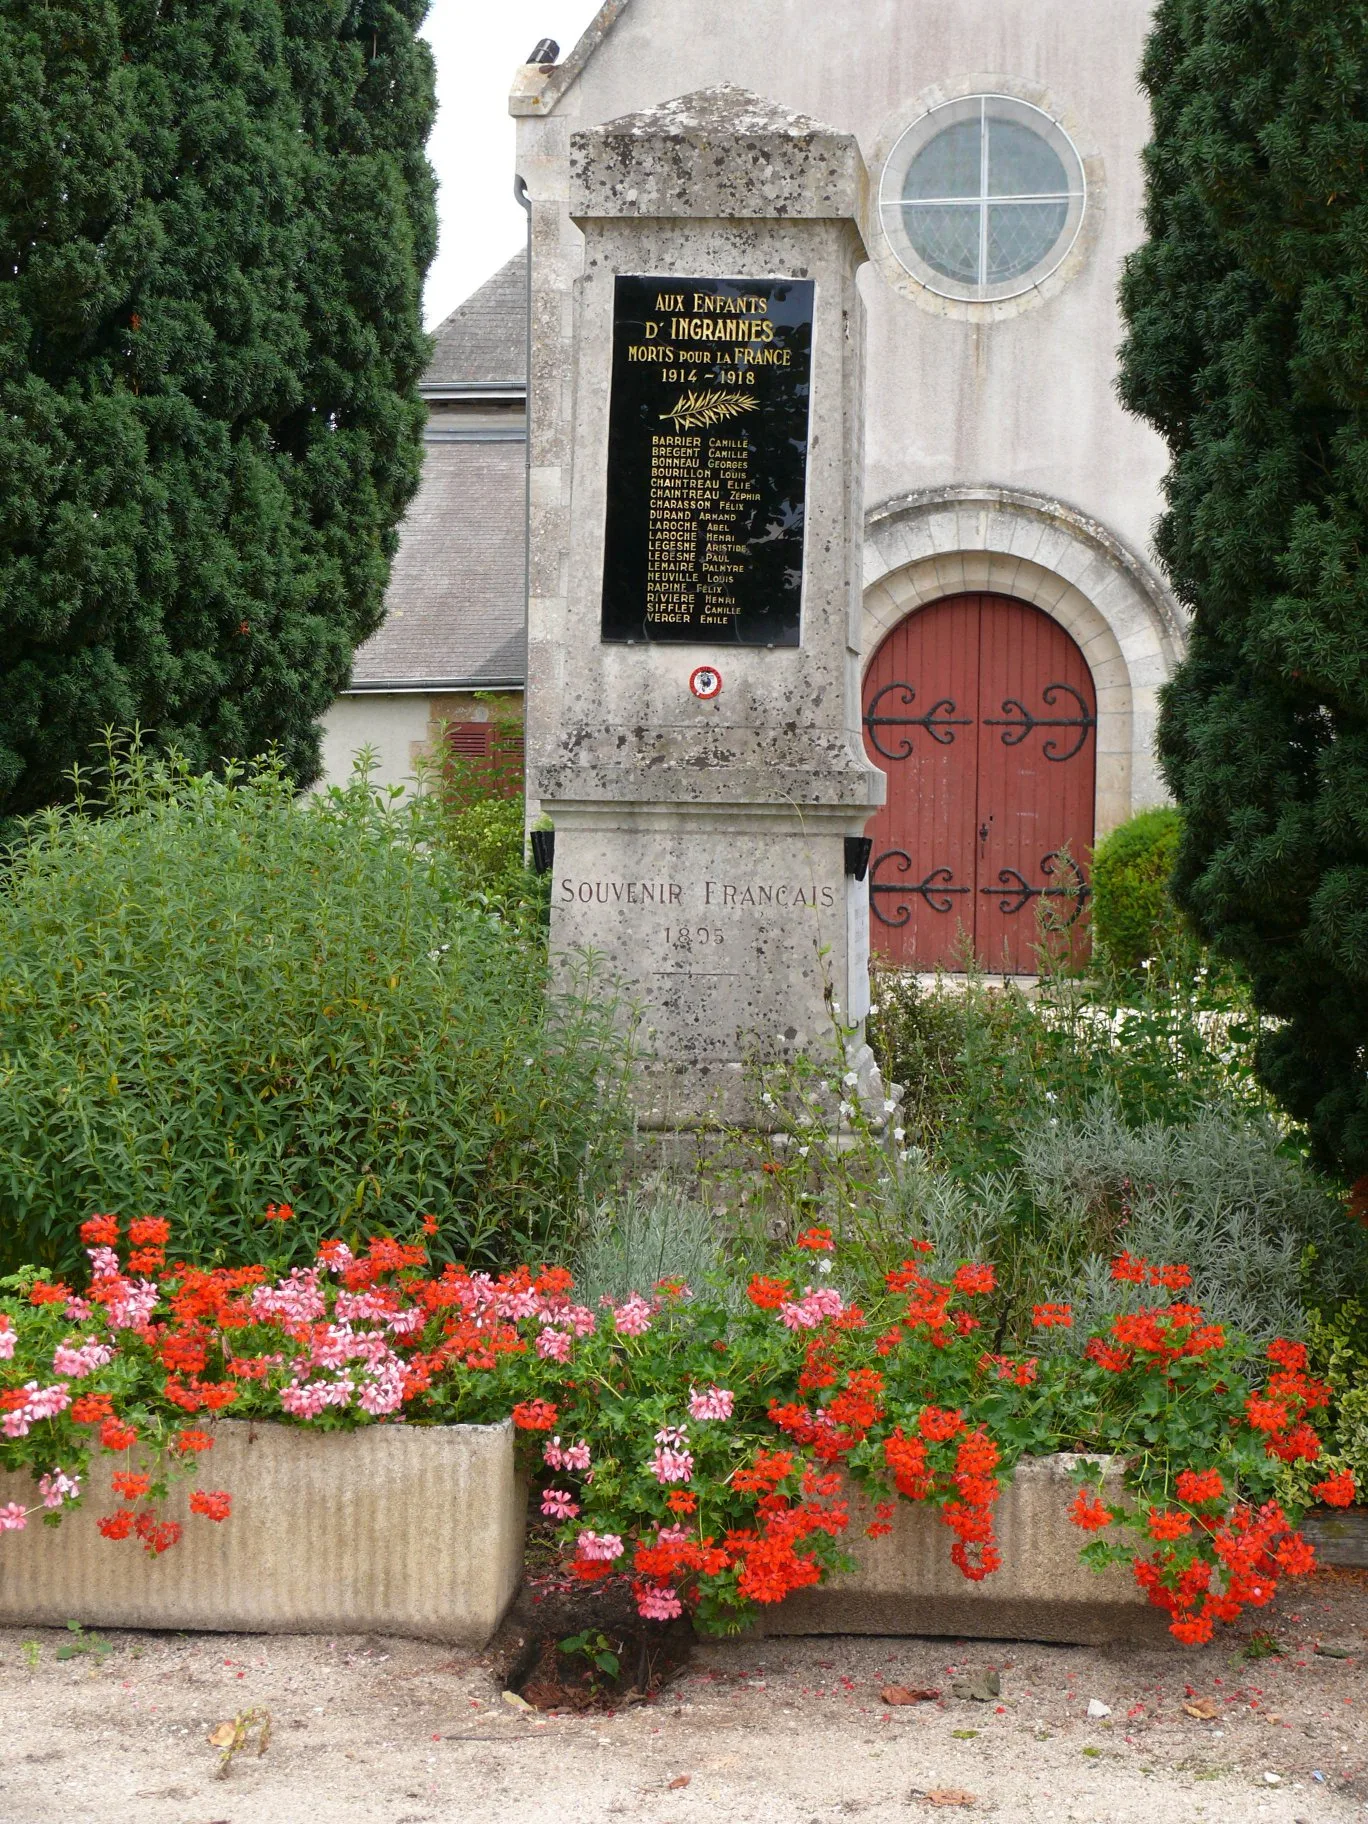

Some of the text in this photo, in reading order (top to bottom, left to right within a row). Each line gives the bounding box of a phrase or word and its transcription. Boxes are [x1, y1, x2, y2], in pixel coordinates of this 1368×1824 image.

[655, 293, 767, 314] AUX ENFANTS
[671, 317, 774, 342] INGRANNES
[628, 345, 792, 366] MORTS POUR LA FRANCE
[662, 369, 697, 383] 1914
[720, 371, 755, 385] 1918
[652, 435, 748, 448] BARRIER CAMILLE
[652, 447, 748, 459] BREGENT CAMILLE
[651, 457, 748, 469] BONNEAU GEORGES
[651, 467, 747, 479] BOURILLON LOUIS
[650, 478, 751, 490] CHAINTREAU ELIE
[650, 488, 719, 499] CHAINTREAU
[650, 499, 711, 510] CHARASSON
[649, 510, 736, 521] DURAND ARMAND
[649, 520, 730, 532] LAROCHE ABEL
[649, 531, 735, 542] LAROCHE HENRI
[648, 541, 747, 552] LEGESNE ARISTIDE
[648, 551, 730, 563] LEGESNE PAUL
[648, 562, 744, 573] LEMAIRE PALMYRE
[647, 572, 734, 584] NEUVILLE LOUIS
[647, 582, 687, 593] RAPINE
[705, 594, 735, 604] HENRI
[646, 602, 741, 615] SIFFLET CAMILLE
[647, 613, 728, 625] VERGER EMILE
[561, 878, 684, 906] SOUVENIR
